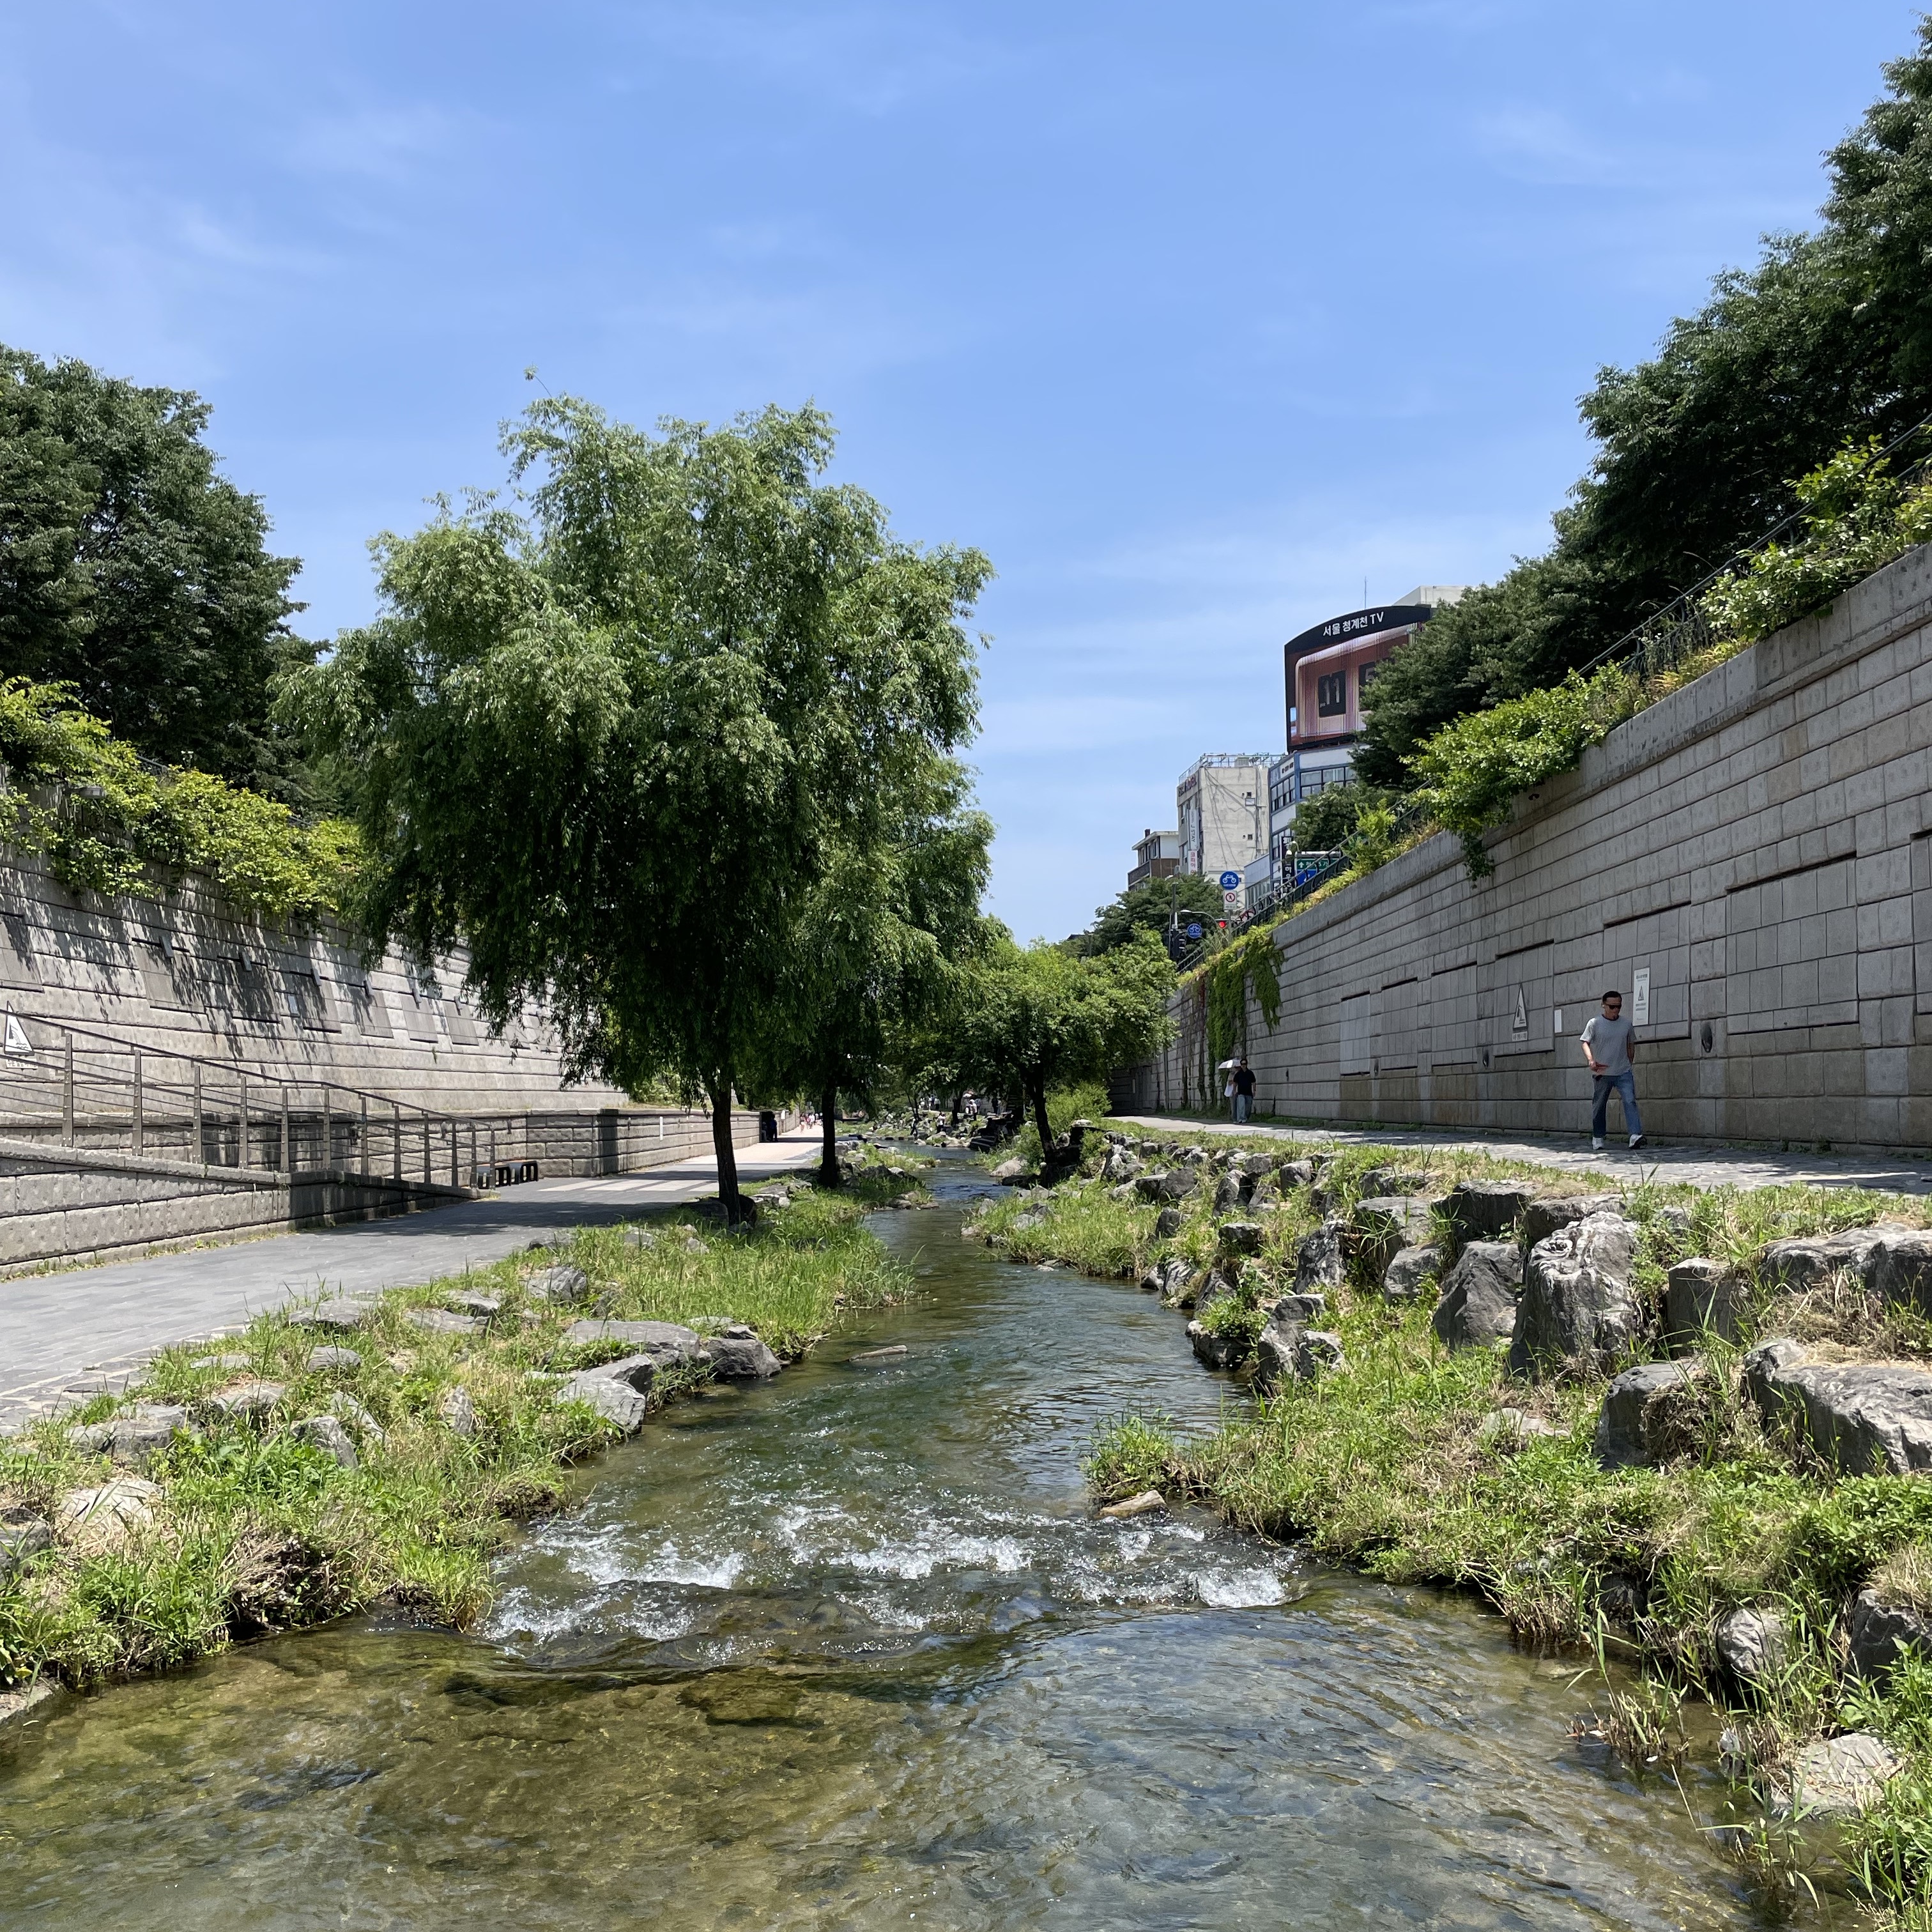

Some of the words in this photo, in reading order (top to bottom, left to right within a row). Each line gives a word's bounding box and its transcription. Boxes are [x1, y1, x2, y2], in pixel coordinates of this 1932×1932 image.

[1322, 623, 1340, 636] 서울
[1342, 615, 1368, 632] 청계천
[1369, 611, 1384, 625] TV
